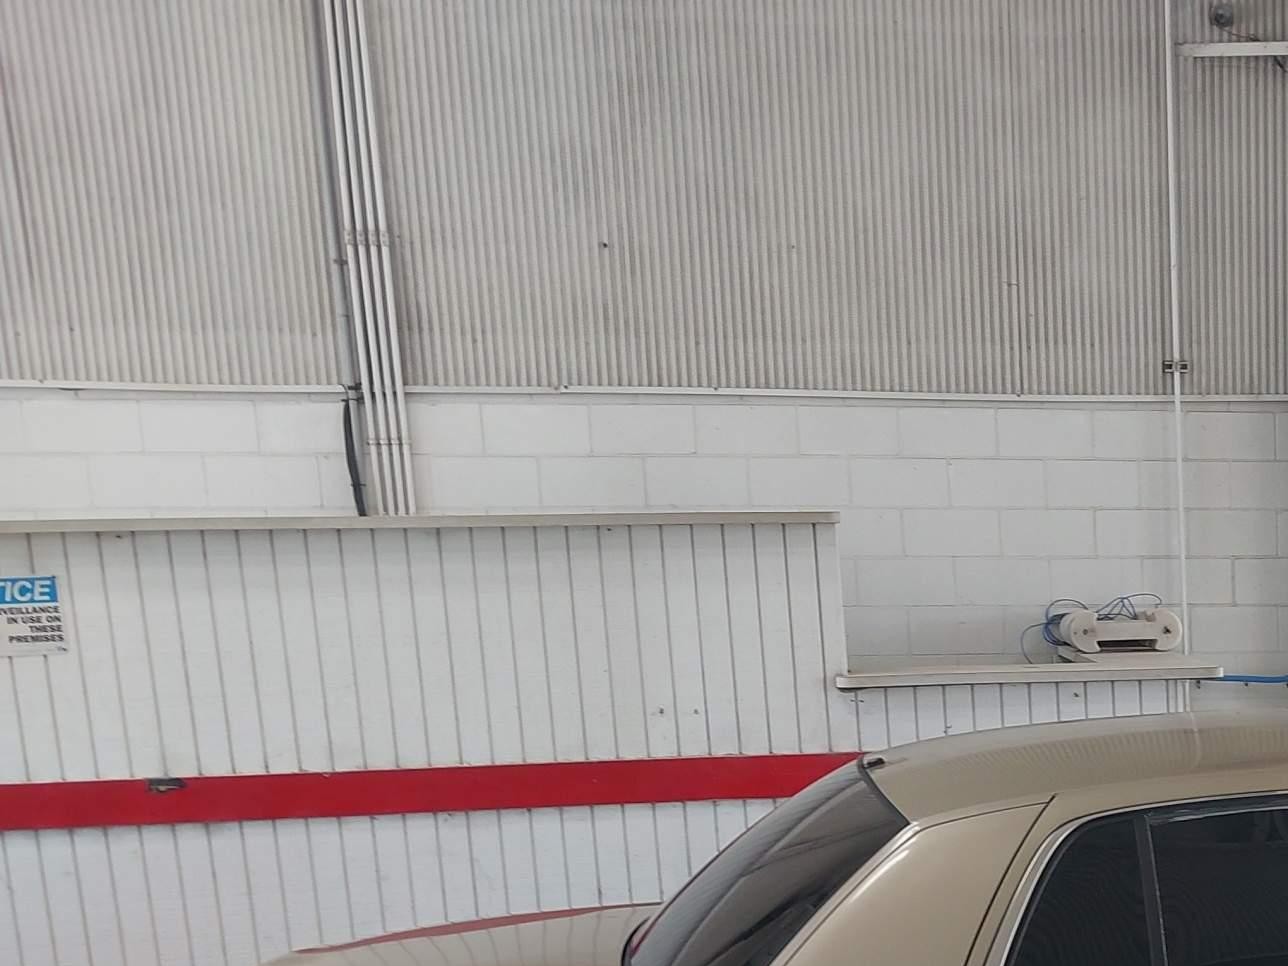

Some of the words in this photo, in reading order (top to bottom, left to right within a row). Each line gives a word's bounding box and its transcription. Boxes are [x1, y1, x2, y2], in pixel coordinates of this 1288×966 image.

[0, 581, 51, 601] ICE
[0, 606, 60, 615] VEILLANCE
[7, 616, 18, 624] IN
[21, 615, 43, 624] USE
[46, 615, 62, 623] ON
[29, 624, 63, 633] THESE
[8, 634, 65, 643] PREMISES
